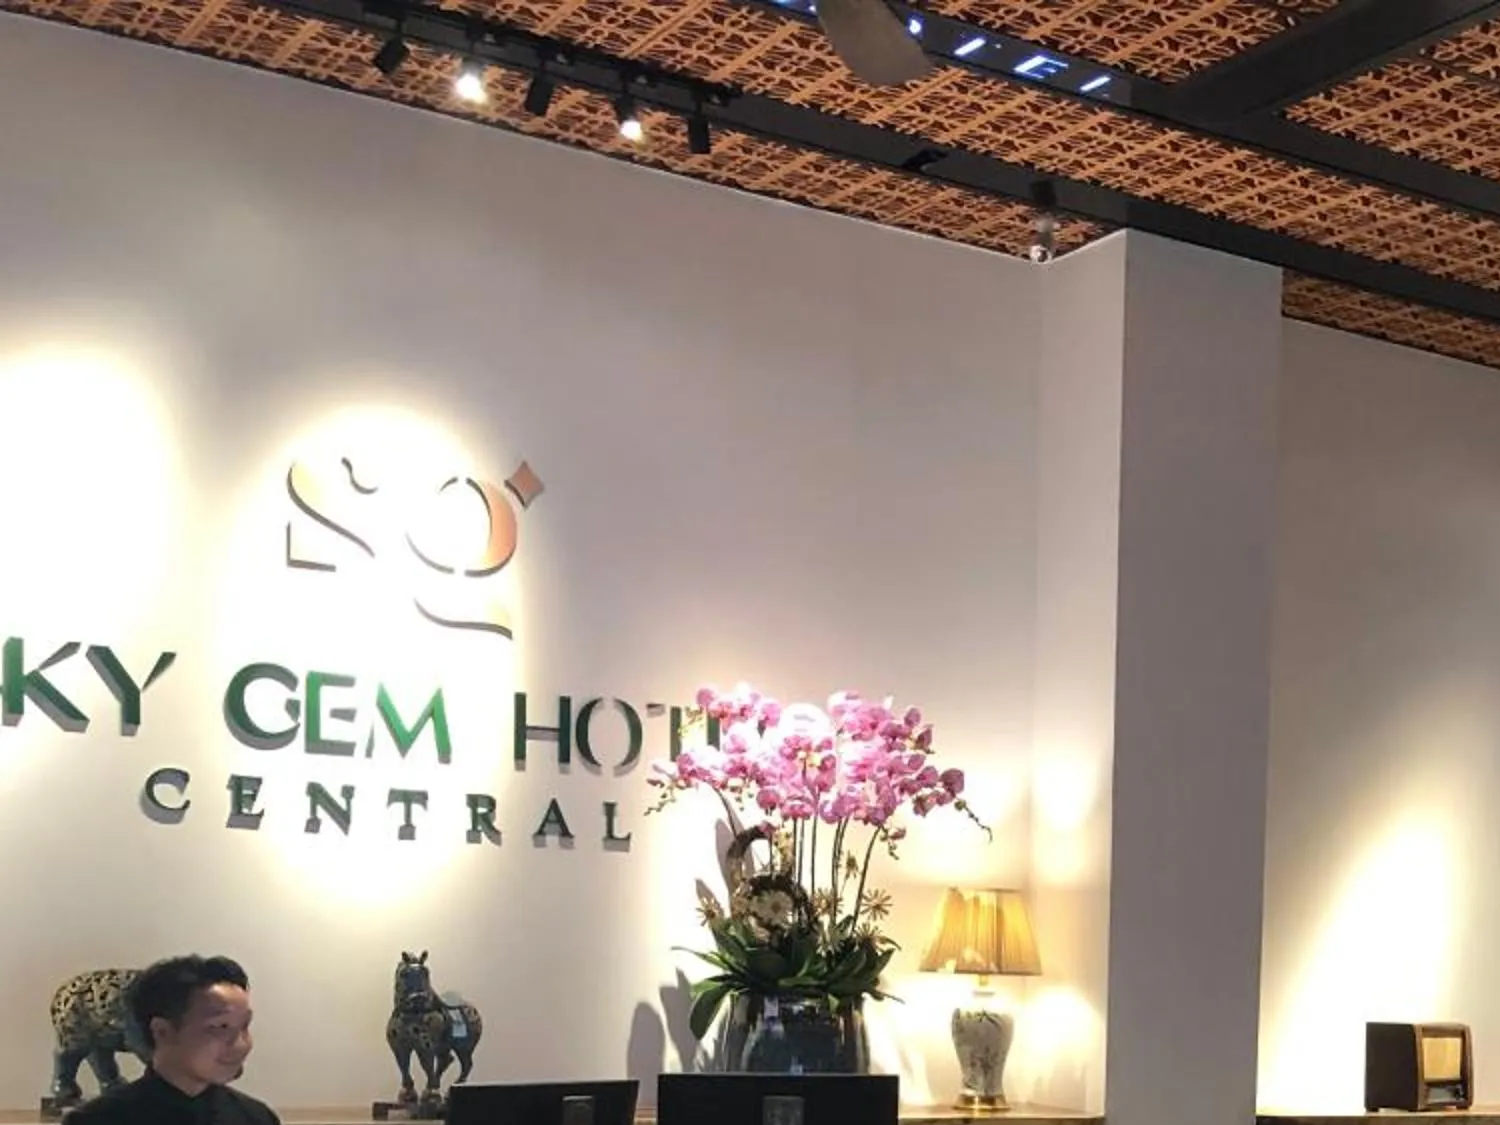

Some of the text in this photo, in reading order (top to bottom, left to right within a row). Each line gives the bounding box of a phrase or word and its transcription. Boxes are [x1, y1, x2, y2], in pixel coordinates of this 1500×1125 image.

[0, 635, 722, 777] KY GEM HOT
[140, 768, 632, 852] CENTRAL
